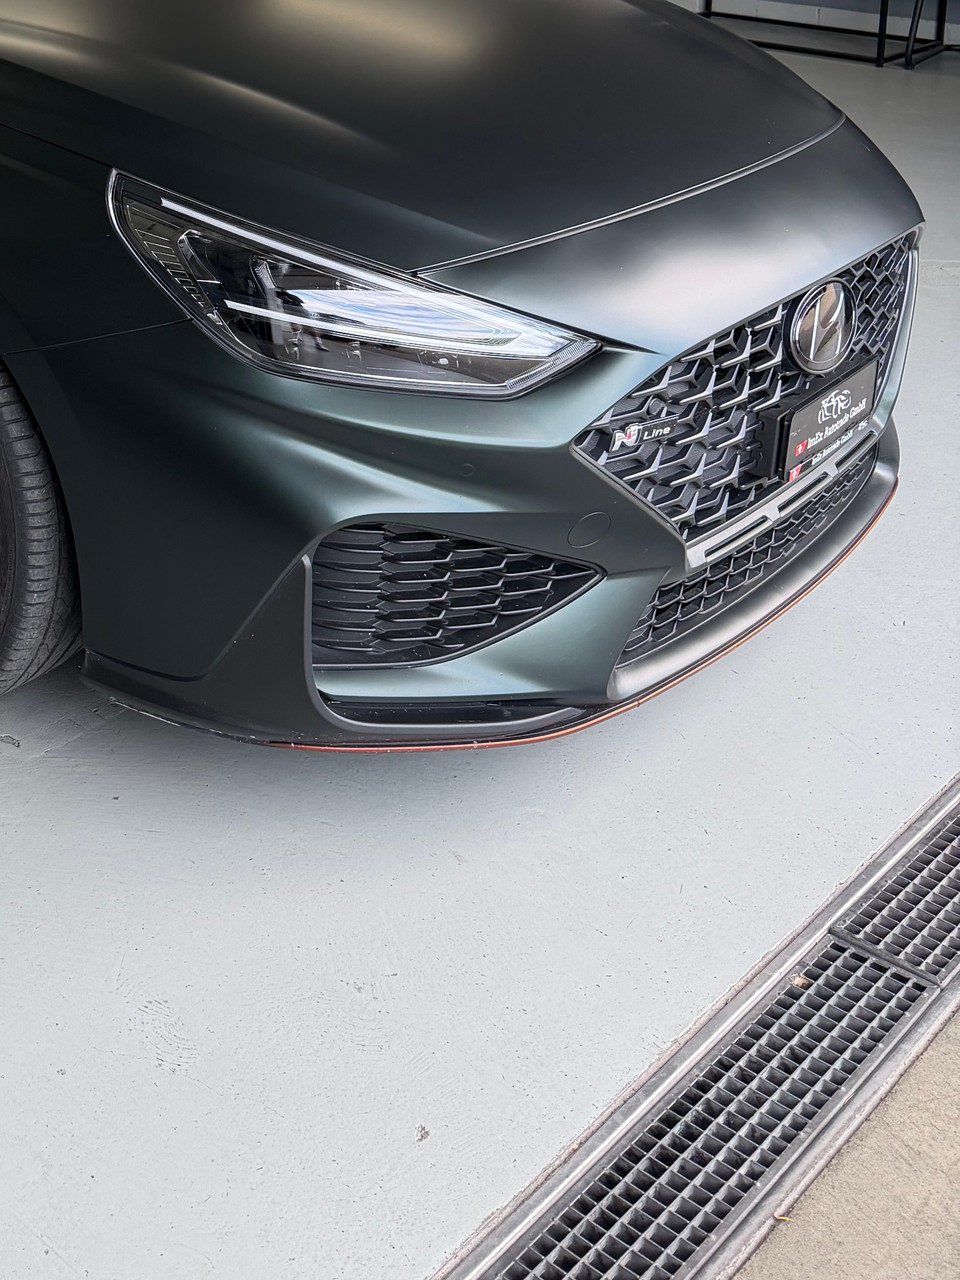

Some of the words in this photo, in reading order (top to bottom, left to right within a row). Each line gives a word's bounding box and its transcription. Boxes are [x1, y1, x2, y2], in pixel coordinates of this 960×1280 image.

[849, 398, 867, 419] GmbH
[611, 425, 639, 452] N
[643, 426, 671, 440] Line
